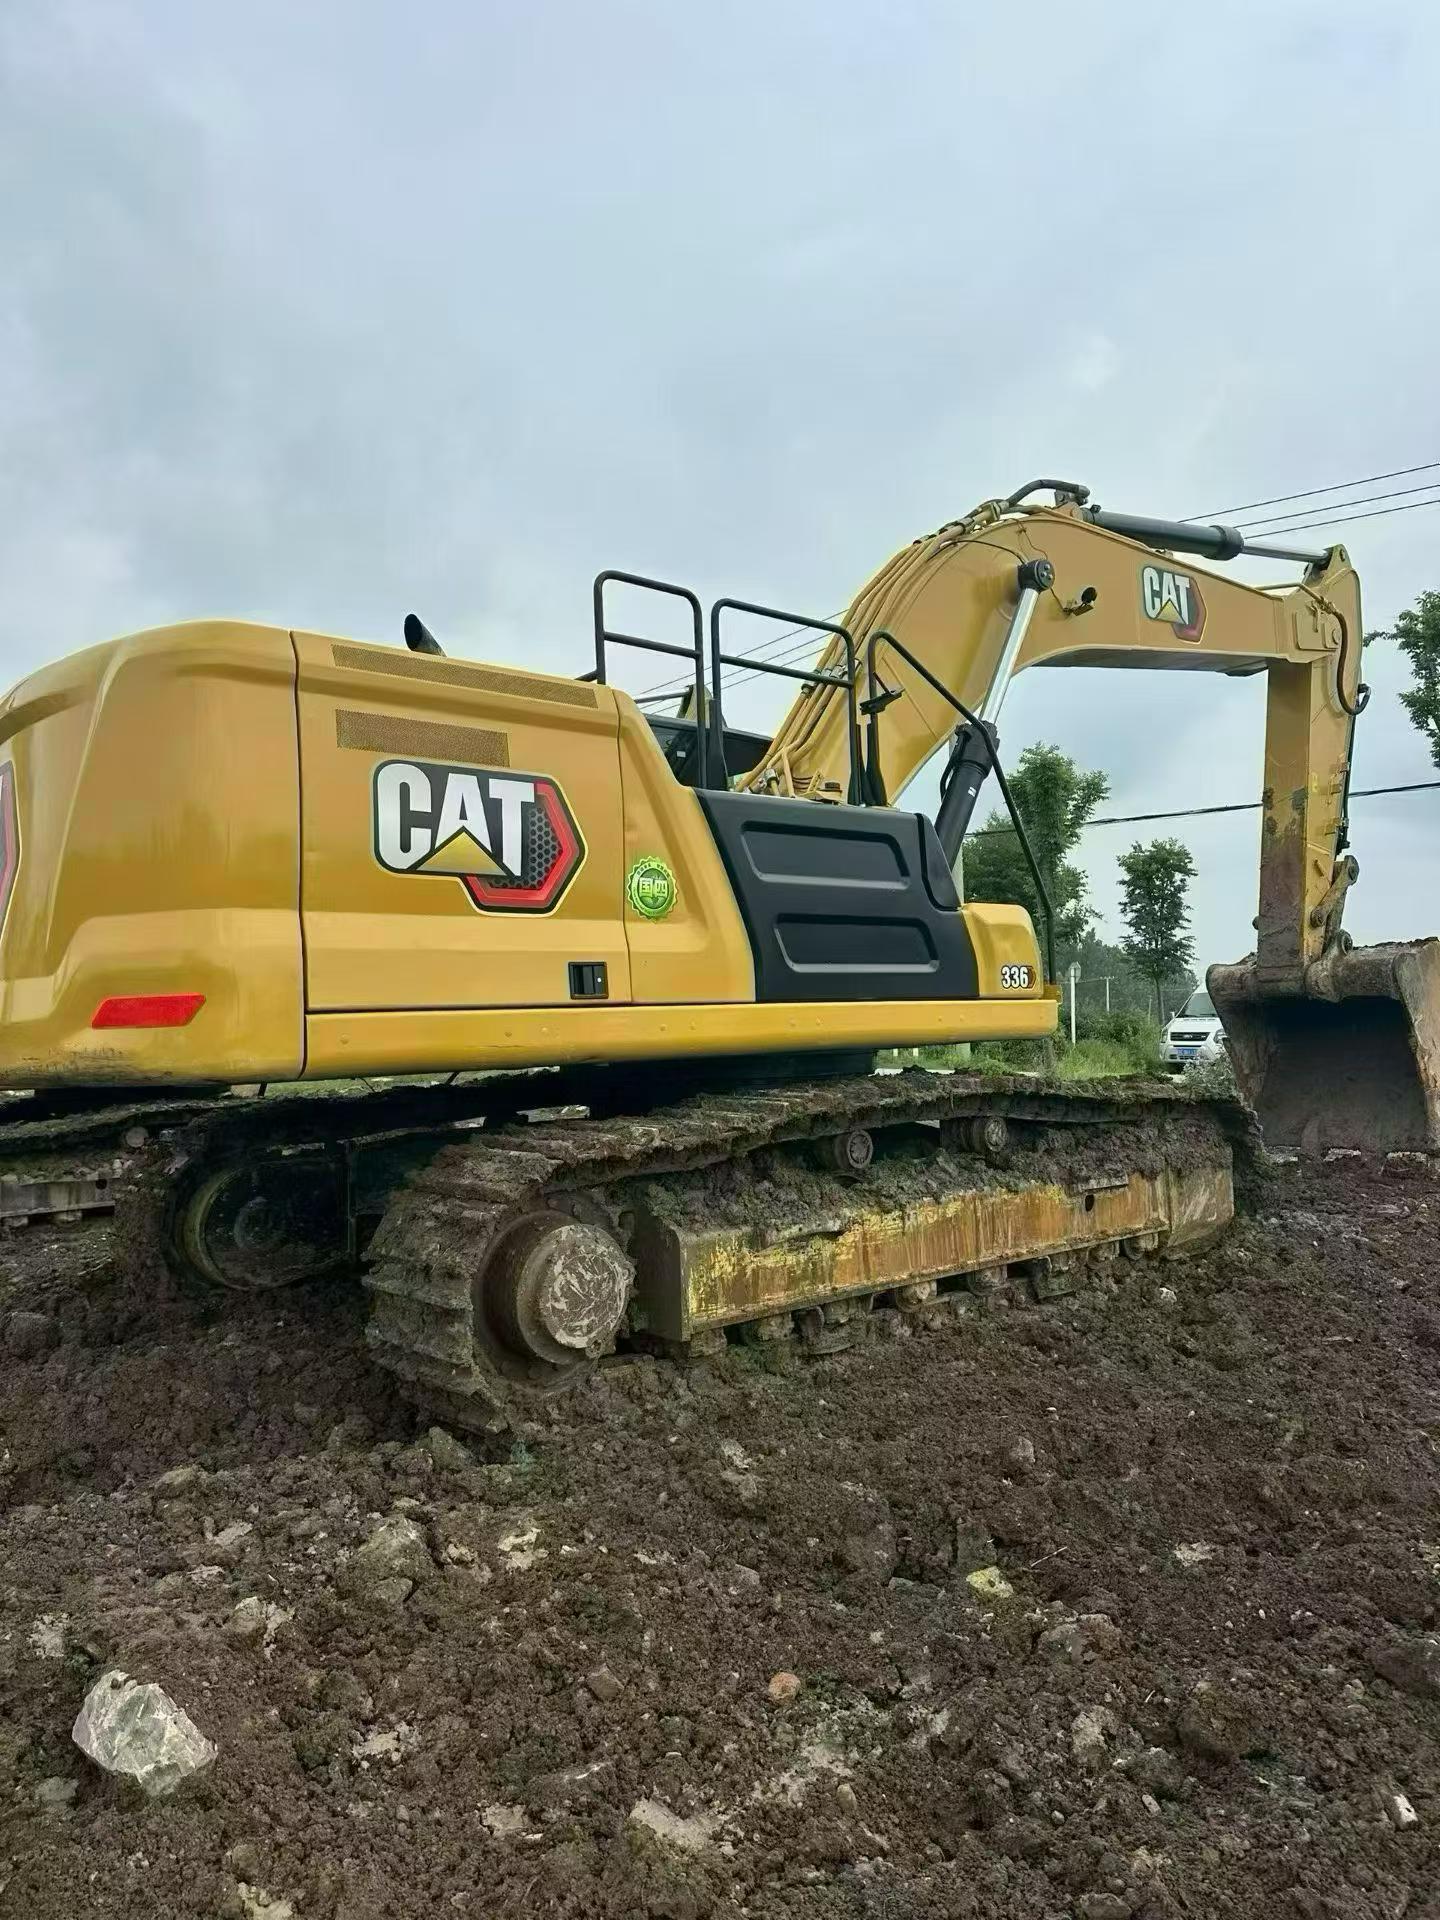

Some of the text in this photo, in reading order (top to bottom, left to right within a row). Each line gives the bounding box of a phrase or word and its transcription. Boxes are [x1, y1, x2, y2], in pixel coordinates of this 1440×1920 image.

[1143, 566, 1191, 625] CAT
[377, 763, 535, 877] CAT
[1001, 965, 1029, 989] 336
